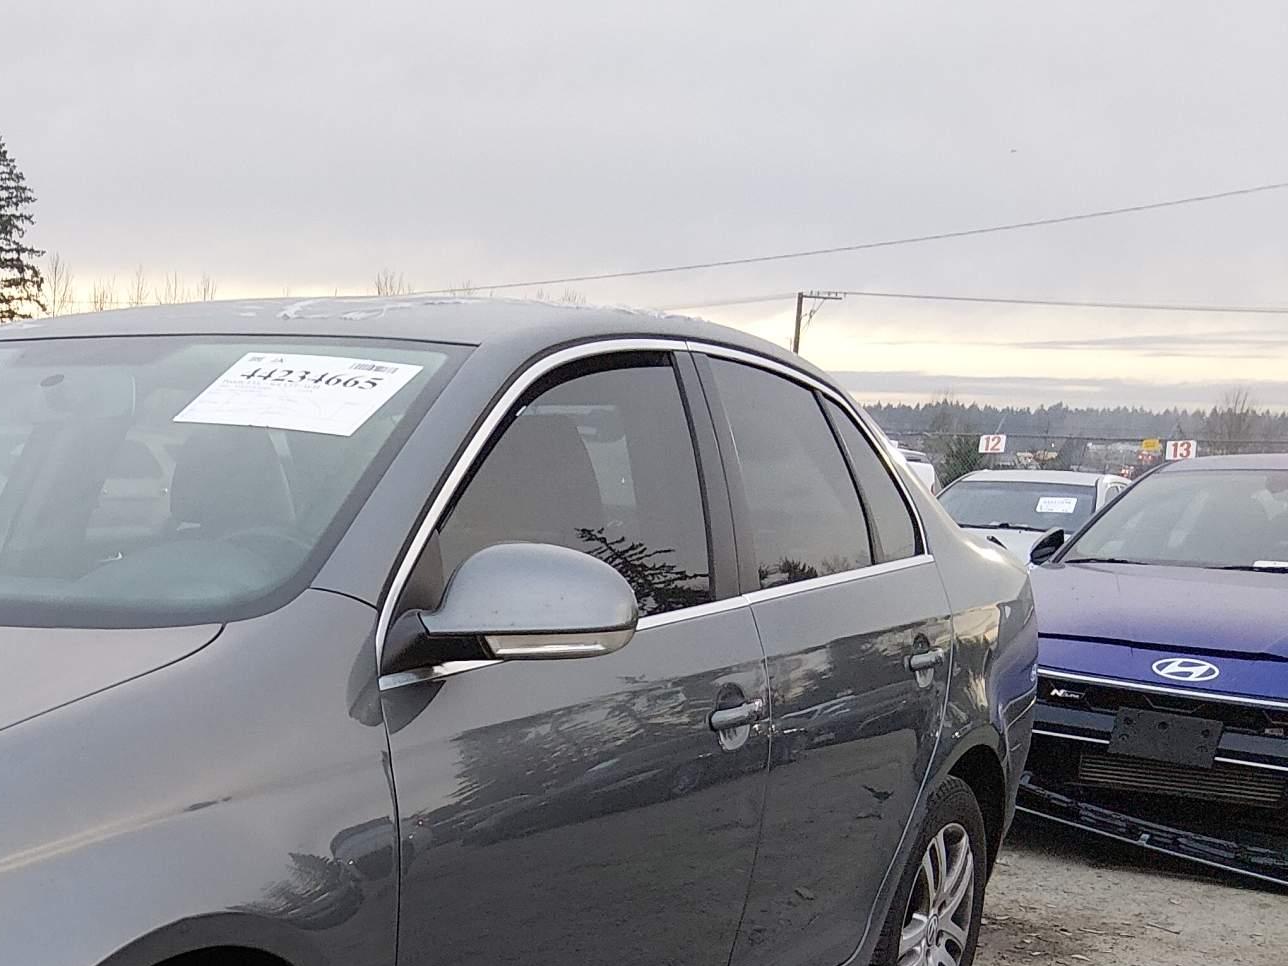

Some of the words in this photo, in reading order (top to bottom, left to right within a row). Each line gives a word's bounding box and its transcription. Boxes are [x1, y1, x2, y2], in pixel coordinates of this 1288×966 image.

[240, 367, 385, 390] 44234665
[983, 435, 1002, 452] 12
[1171, 441, 1192, 458] 13
